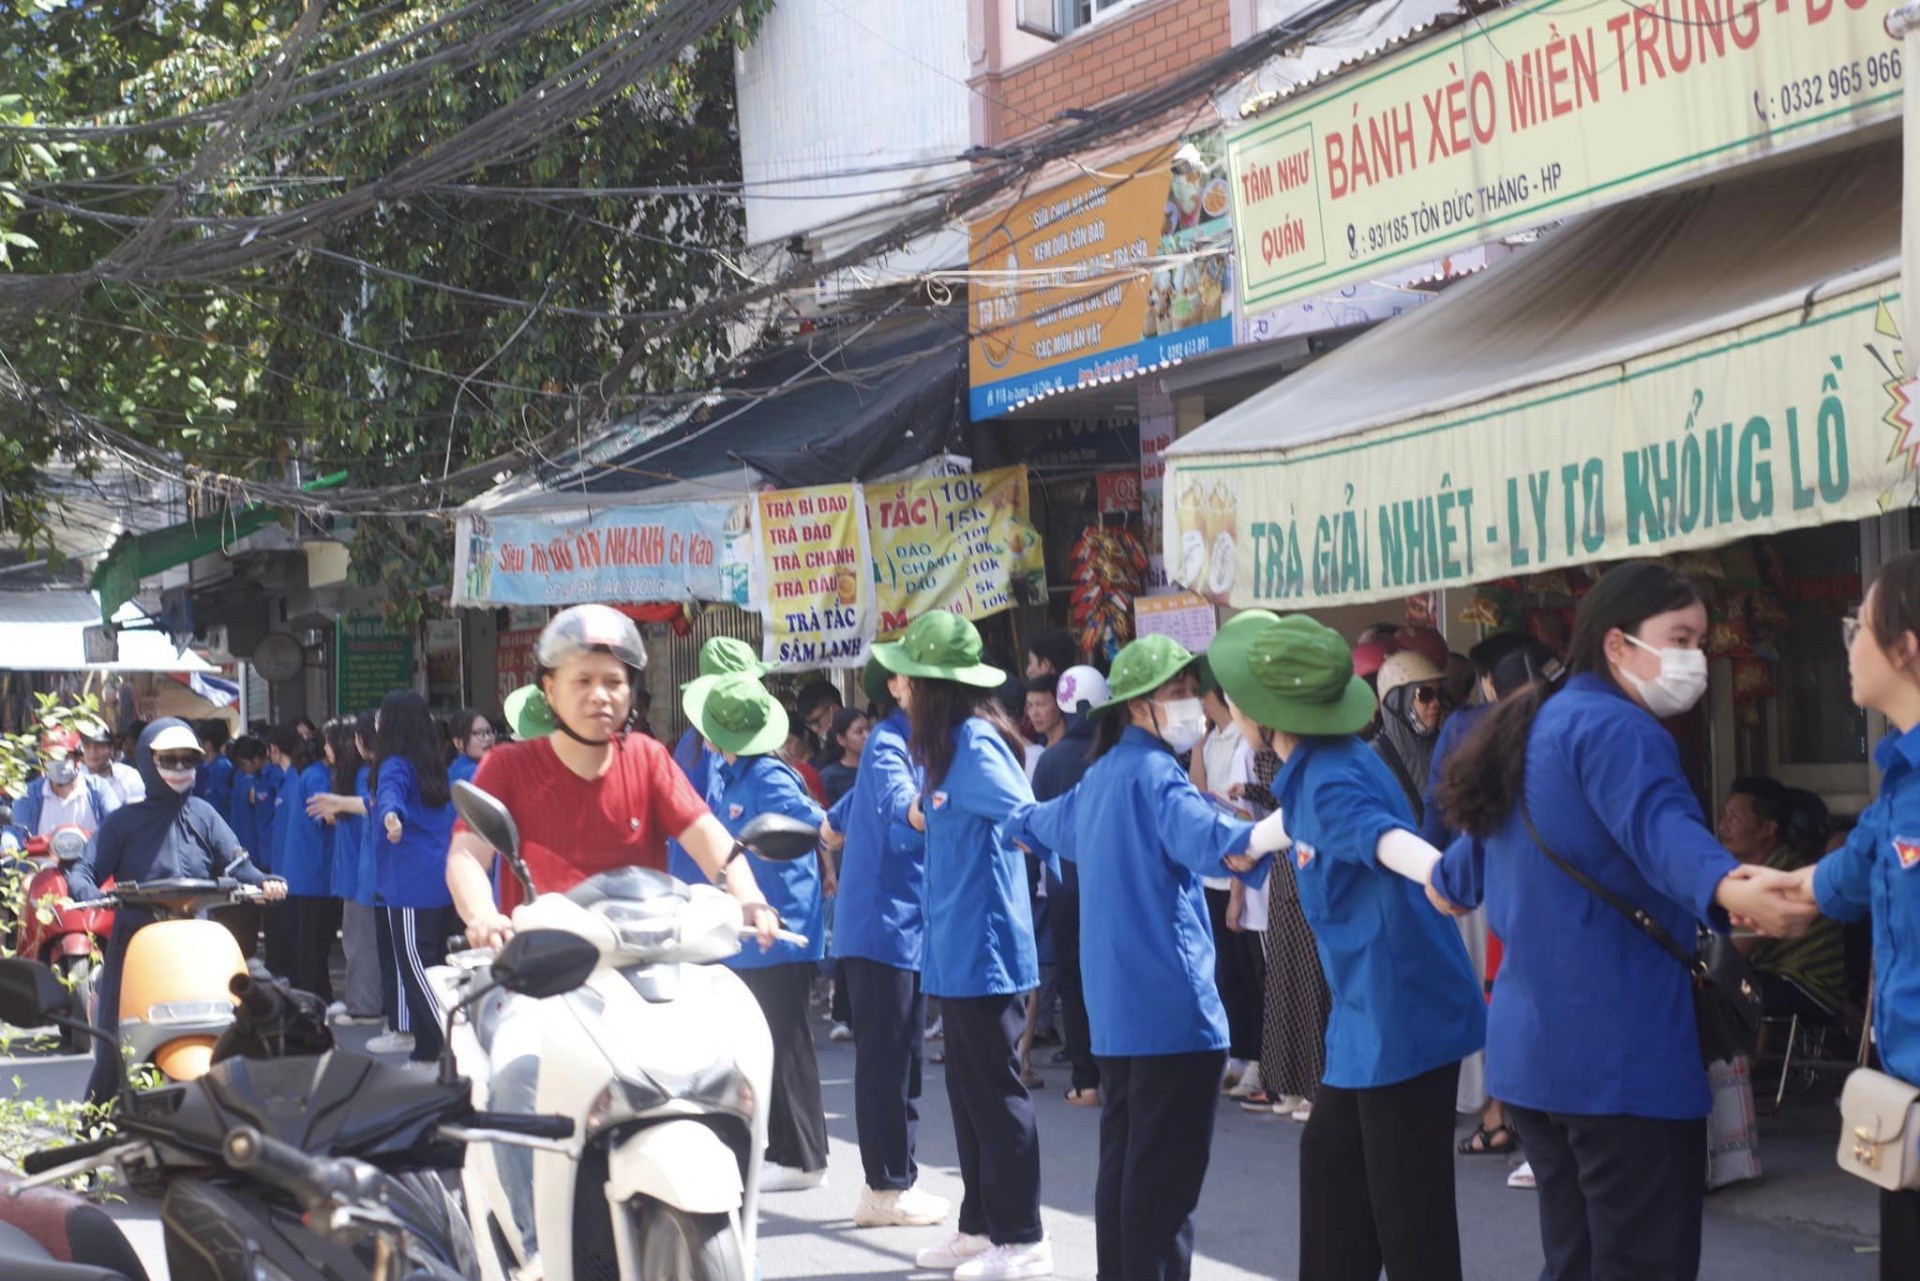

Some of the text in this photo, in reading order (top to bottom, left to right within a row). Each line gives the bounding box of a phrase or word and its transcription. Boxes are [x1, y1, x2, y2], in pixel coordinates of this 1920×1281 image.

[1781, 75, 1824, 115] 0332
[1828, 61, 1862, 100] 965
[1867, 48, 1902, 87] 966
[1325, 101, 1417, 200] BÁNH
[1422, 61, 1496, 164] XÈO
[1505, 24, 1600, 134] MIỀN
[1606, 0, 1761, 93] TRUNG
[1241, 148, 1310, 206] TÂM NHƯ
[1368, 215, 1409, 250] 93/185
[1443, 189, 1475, 225] ĐỨC
[1541, 163, 1562, 193] HP
[1261, 213, 1306, 266] QUÁN
[940, 479, 983, 503] 10k
[1251, 503, 1304, 599] TRÀ
[1312, 483, 1370, 597] GIẢI
[1507, 470, 1549, 568] LY
[1562, 457, 1605, 557] TO
[1623, 389, 1773, 546] KHỔNG
[1786, 354, 1849, 511] LỒ
[766, 498, 795, 518] TRÀ
[605, 526, 666, 565] NHANH
[769, 521, 832, 545] TRÀ ĐÀO
[773, 547, 855, 571] TRÀ CHANH
[775, 577, 804, 598] TRÀ
[786, 605, 821, 633] TRÀ
[780, 637, 815, 662] SÂM
